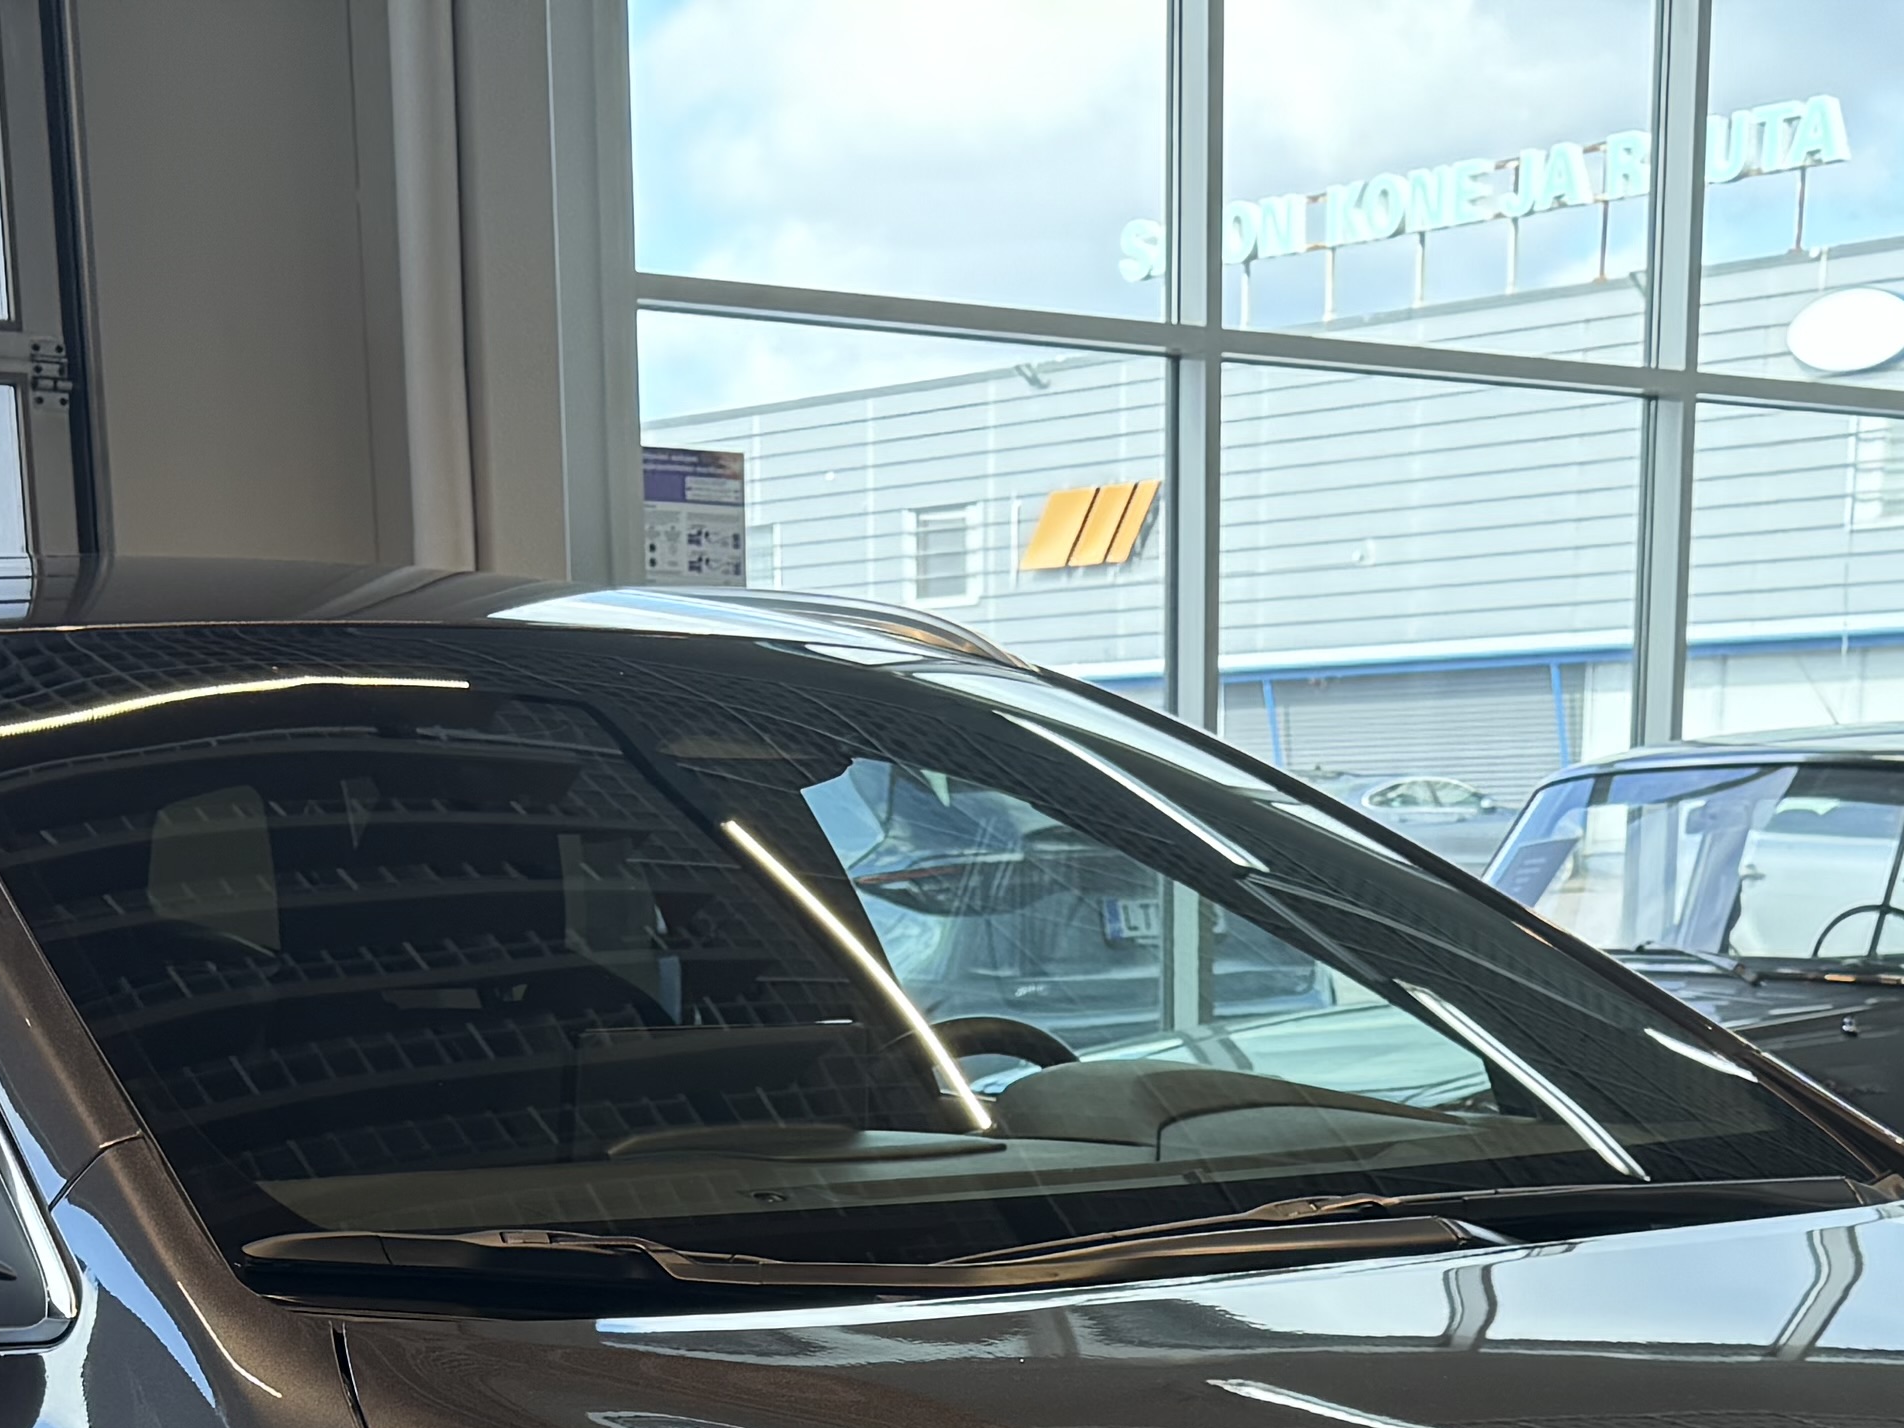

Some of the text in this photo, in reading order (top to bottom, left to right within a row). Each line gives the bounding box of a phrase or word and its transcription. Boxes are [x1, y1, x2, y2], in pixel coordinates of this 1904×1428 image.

[1118, 94, 1851, 283] SON KONE JA RUTA
